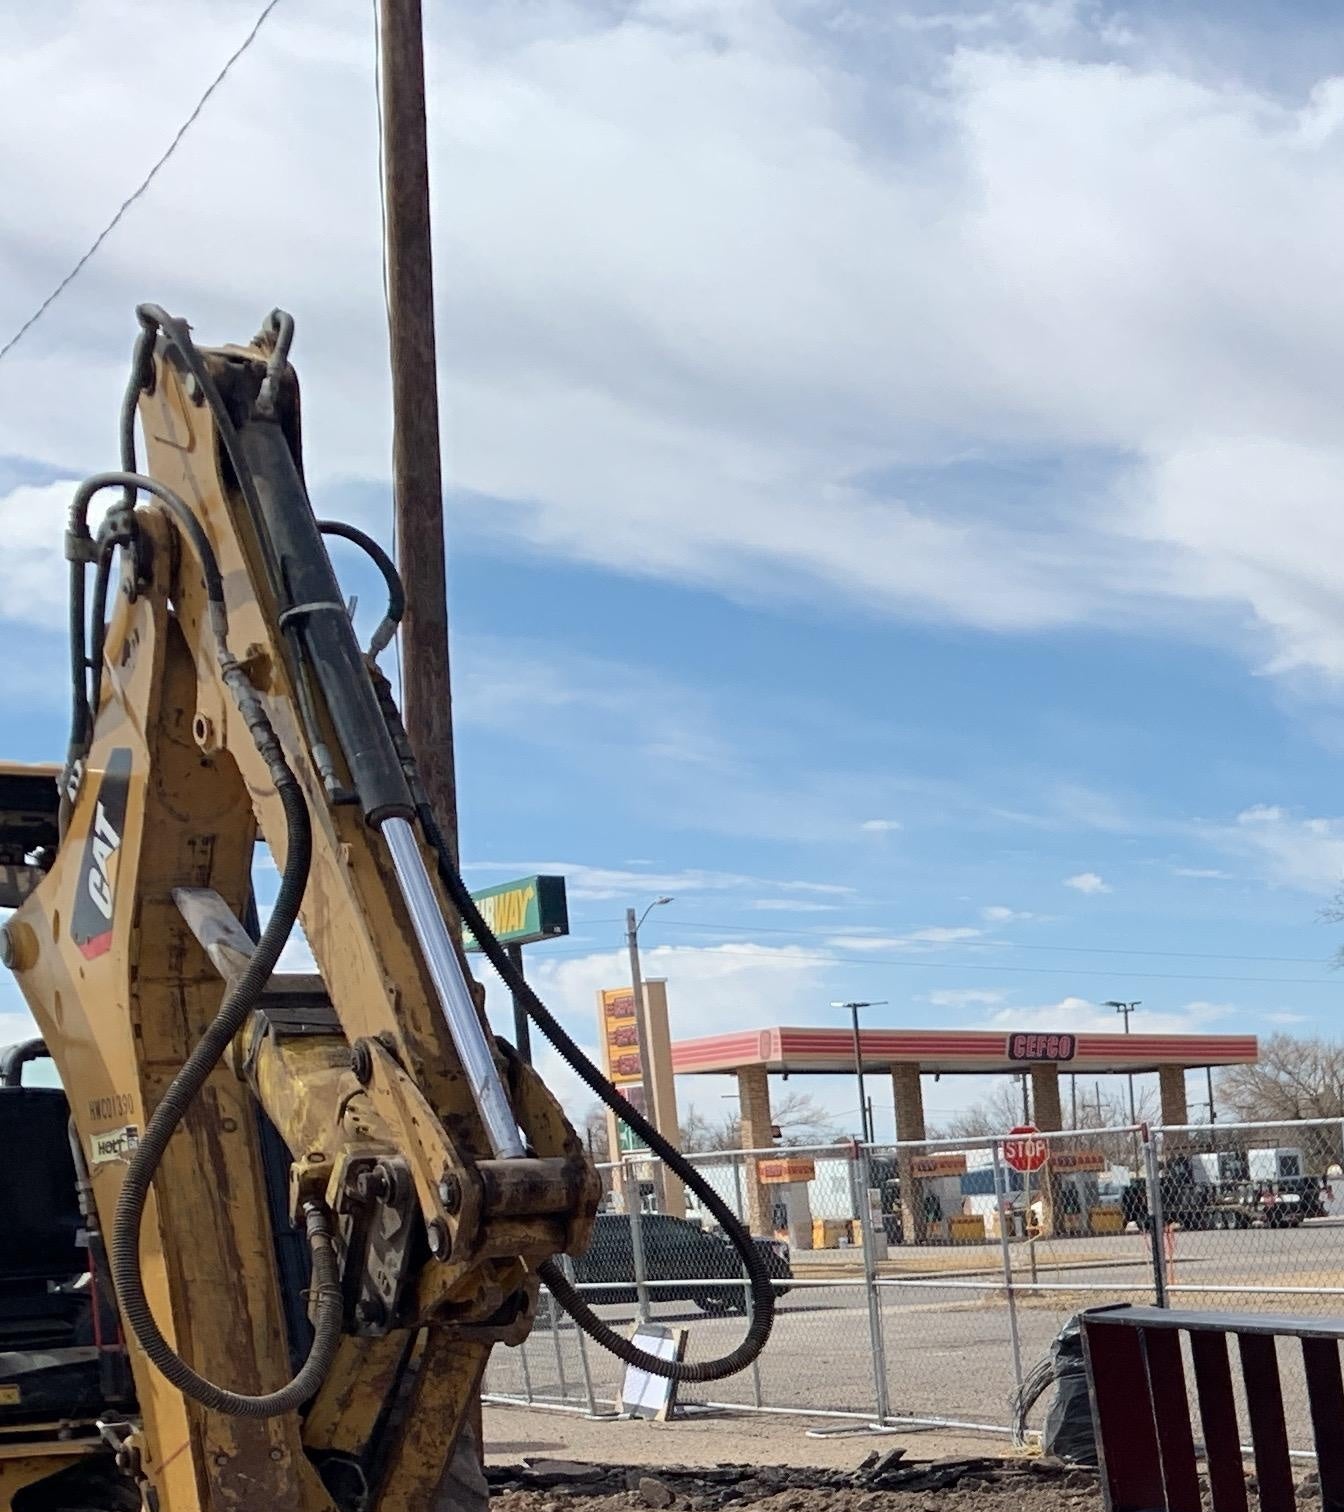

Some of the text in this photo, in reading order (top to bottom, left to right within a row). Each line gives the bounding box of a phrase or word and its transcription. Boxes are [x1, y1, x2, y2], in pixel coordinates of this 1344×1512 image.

[88, 800, 121, 920] CAT
[1013, 1034, 1071, 1058] CEFCO
[1006, 1140, 1046, 1159] STOP
